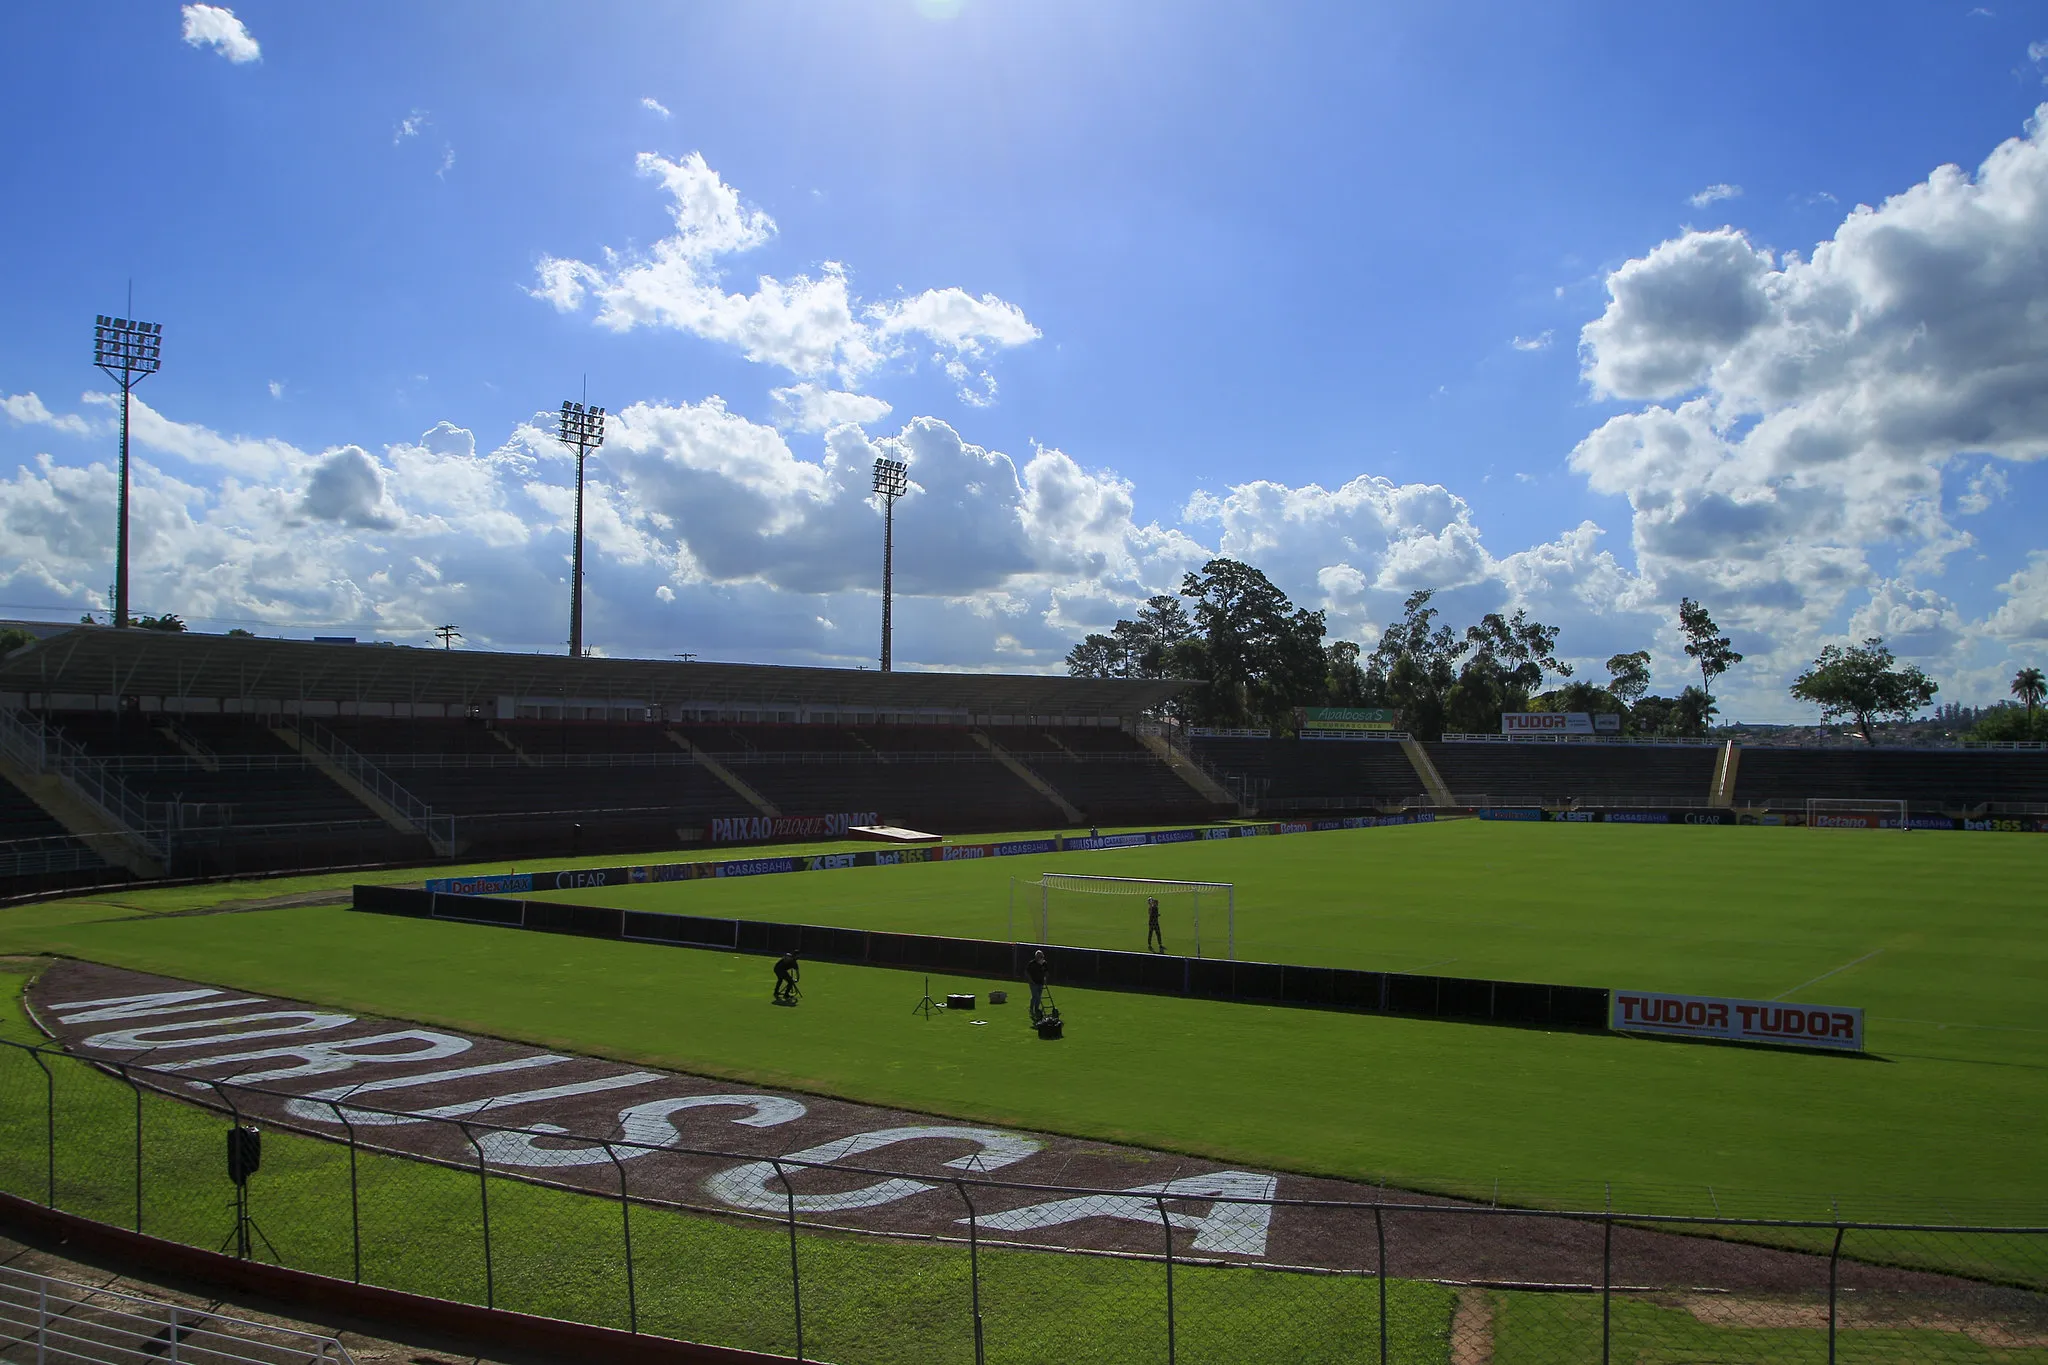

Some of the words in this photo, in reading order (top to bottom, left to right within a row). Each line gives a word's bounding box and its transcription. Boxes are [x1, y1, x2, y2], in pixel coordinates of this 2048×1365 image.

[1504, 715, 1566, 729] TUDOR
[1684, 813, 1720, 824] CLEAR
[1817, 815, 1867, 828] Betano
[1964, 818, 2021, 831] bet365
[1240, 826, 1270, 838] bet365
[1280, 823, 1307, 834] Betano
[876, 849, 925, 866] bet365
[943, 847, 984, 861] Betano
[452, 879, 501, 894] Dorflex
[556, 871, 606, 889] CLEAR
[1618, 996, 1729, 1028] TUDOR
[1735, 1005, 1854, 1039] TUDOR
